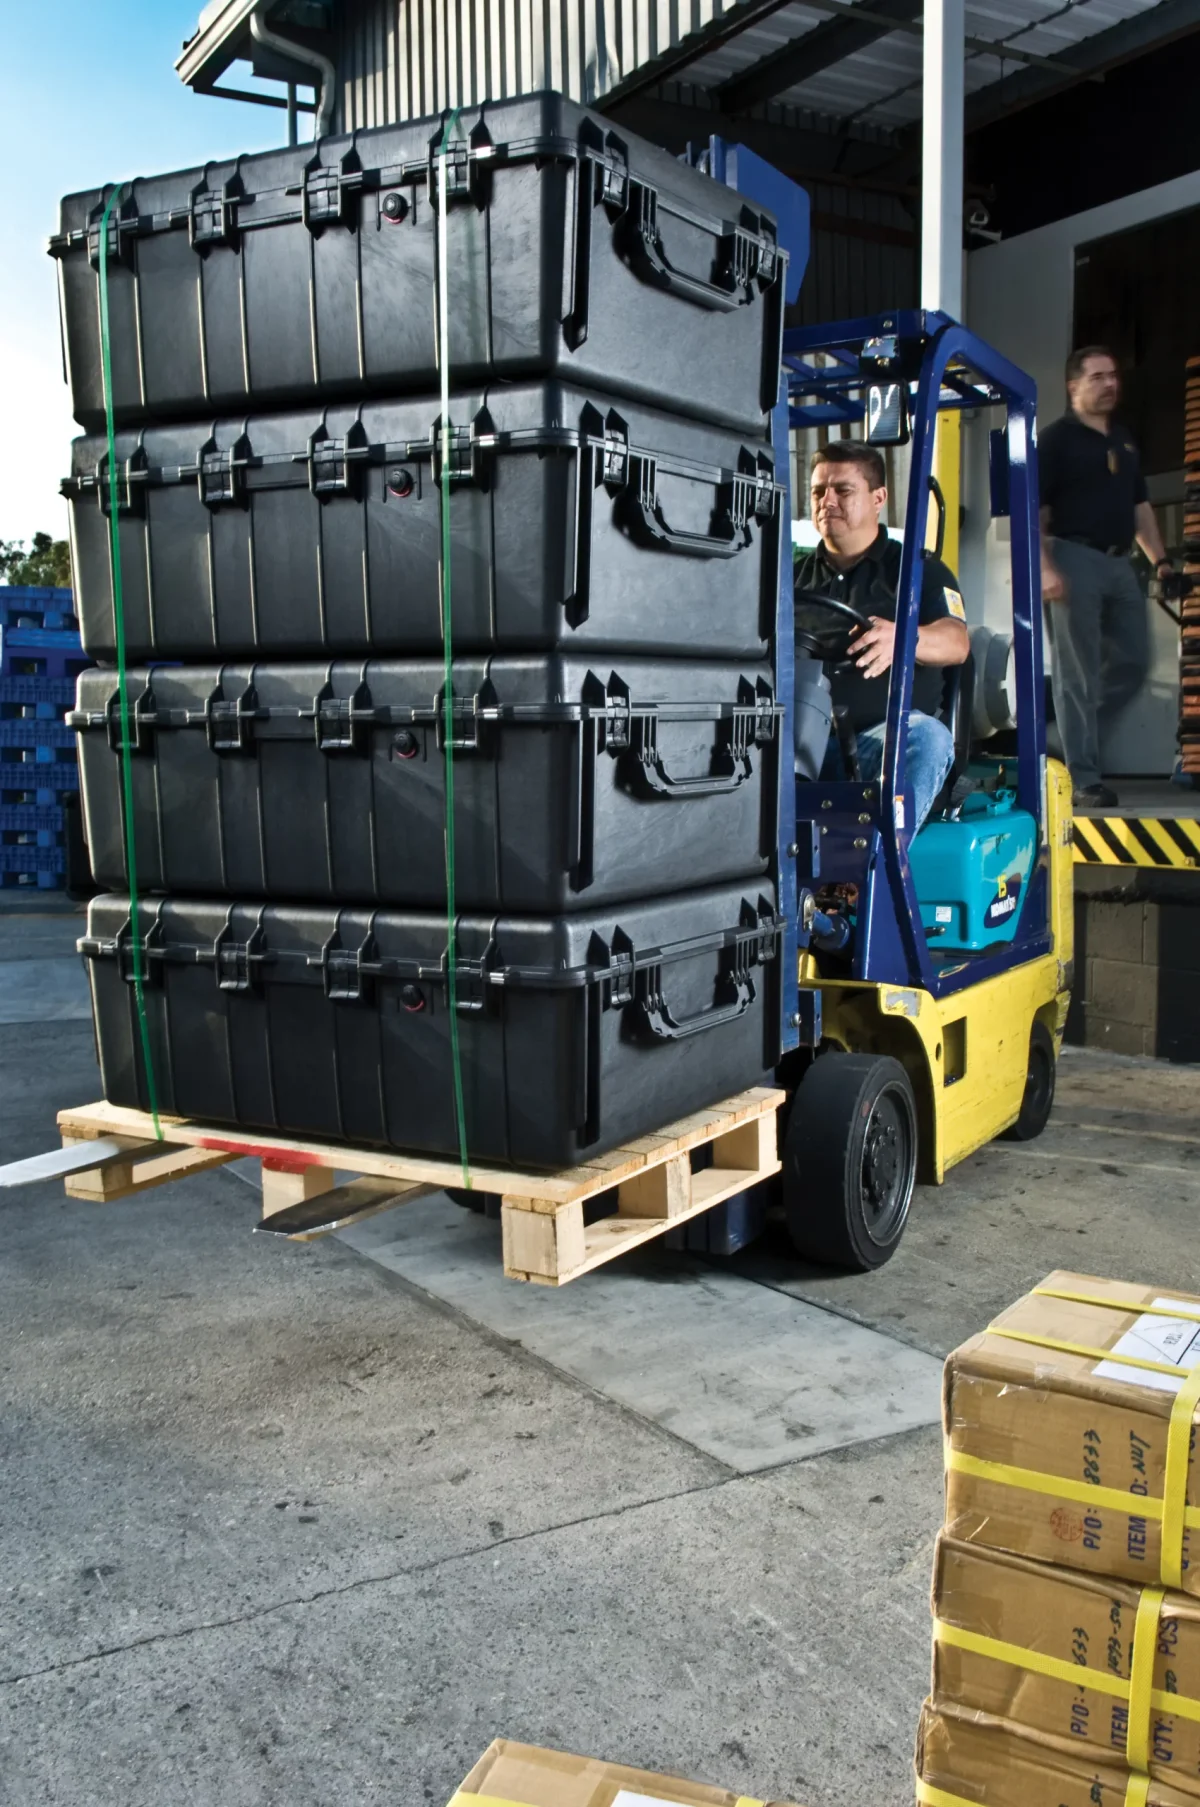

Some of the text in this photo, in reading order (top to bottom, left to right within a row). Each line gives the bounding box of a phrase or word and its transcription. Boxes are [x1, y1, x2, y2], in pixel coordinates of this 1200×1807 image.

[1083, 1428, 1101, 1487] 8633
[1128, 1515, 1147, 1561] ITEM
[1111, 1705, 1129, 1748] ITEM
